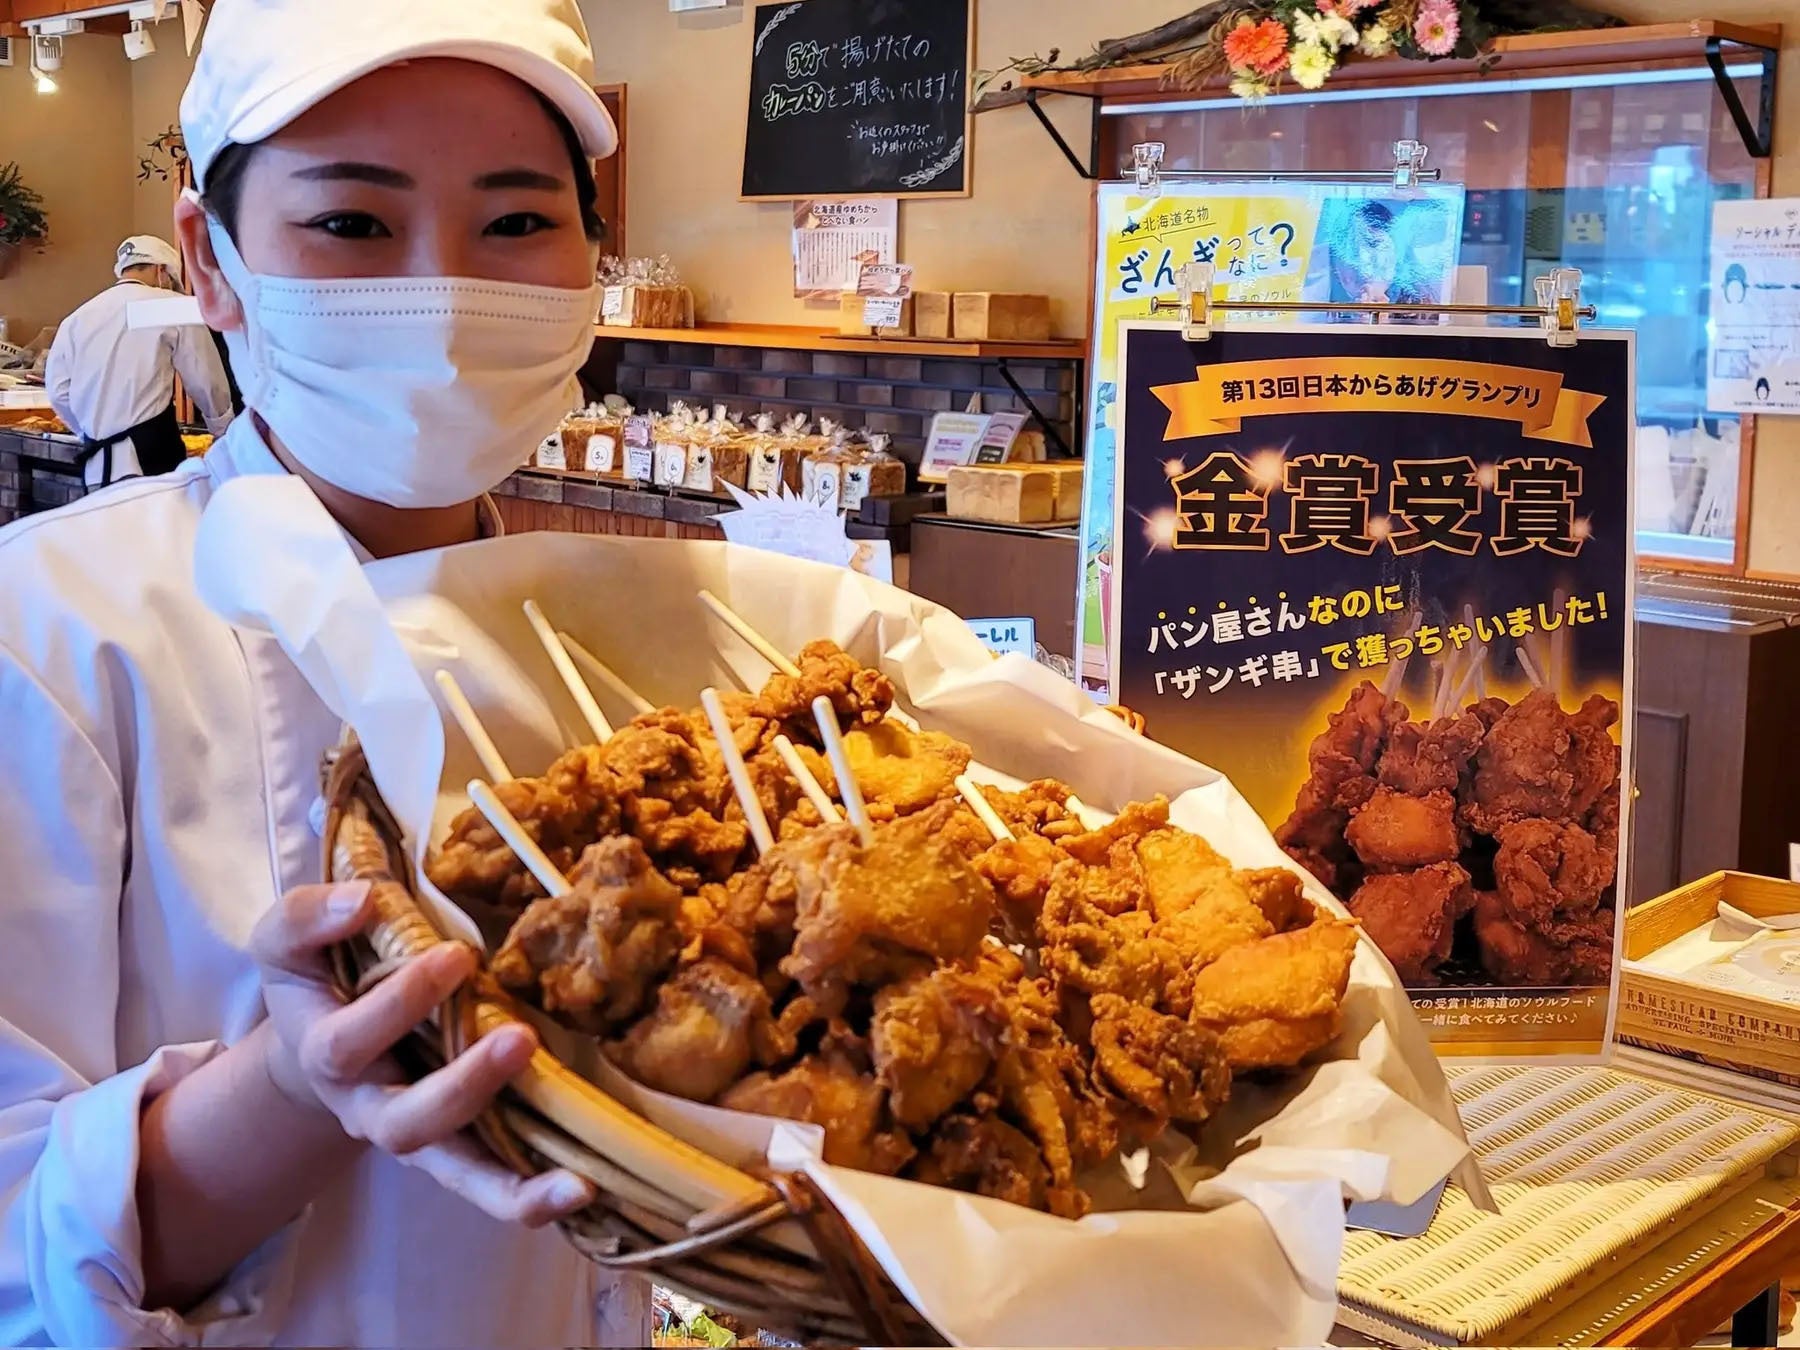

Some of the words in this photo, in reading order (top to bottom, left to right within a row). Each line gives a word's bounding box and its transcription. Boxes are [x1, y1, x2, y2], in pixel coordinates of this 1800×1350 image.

[1143, 206, 1209, 232] 北海道名物
[1220, 373, 1541, 409] 第13回日本からあげグランプリ
[1171, 452, 1584, 557] 金賞受賞
[1147, 584, 1404, 655] パン屋さんなのに
[1627, 988, 1717, 1021] HOMESTEAD
